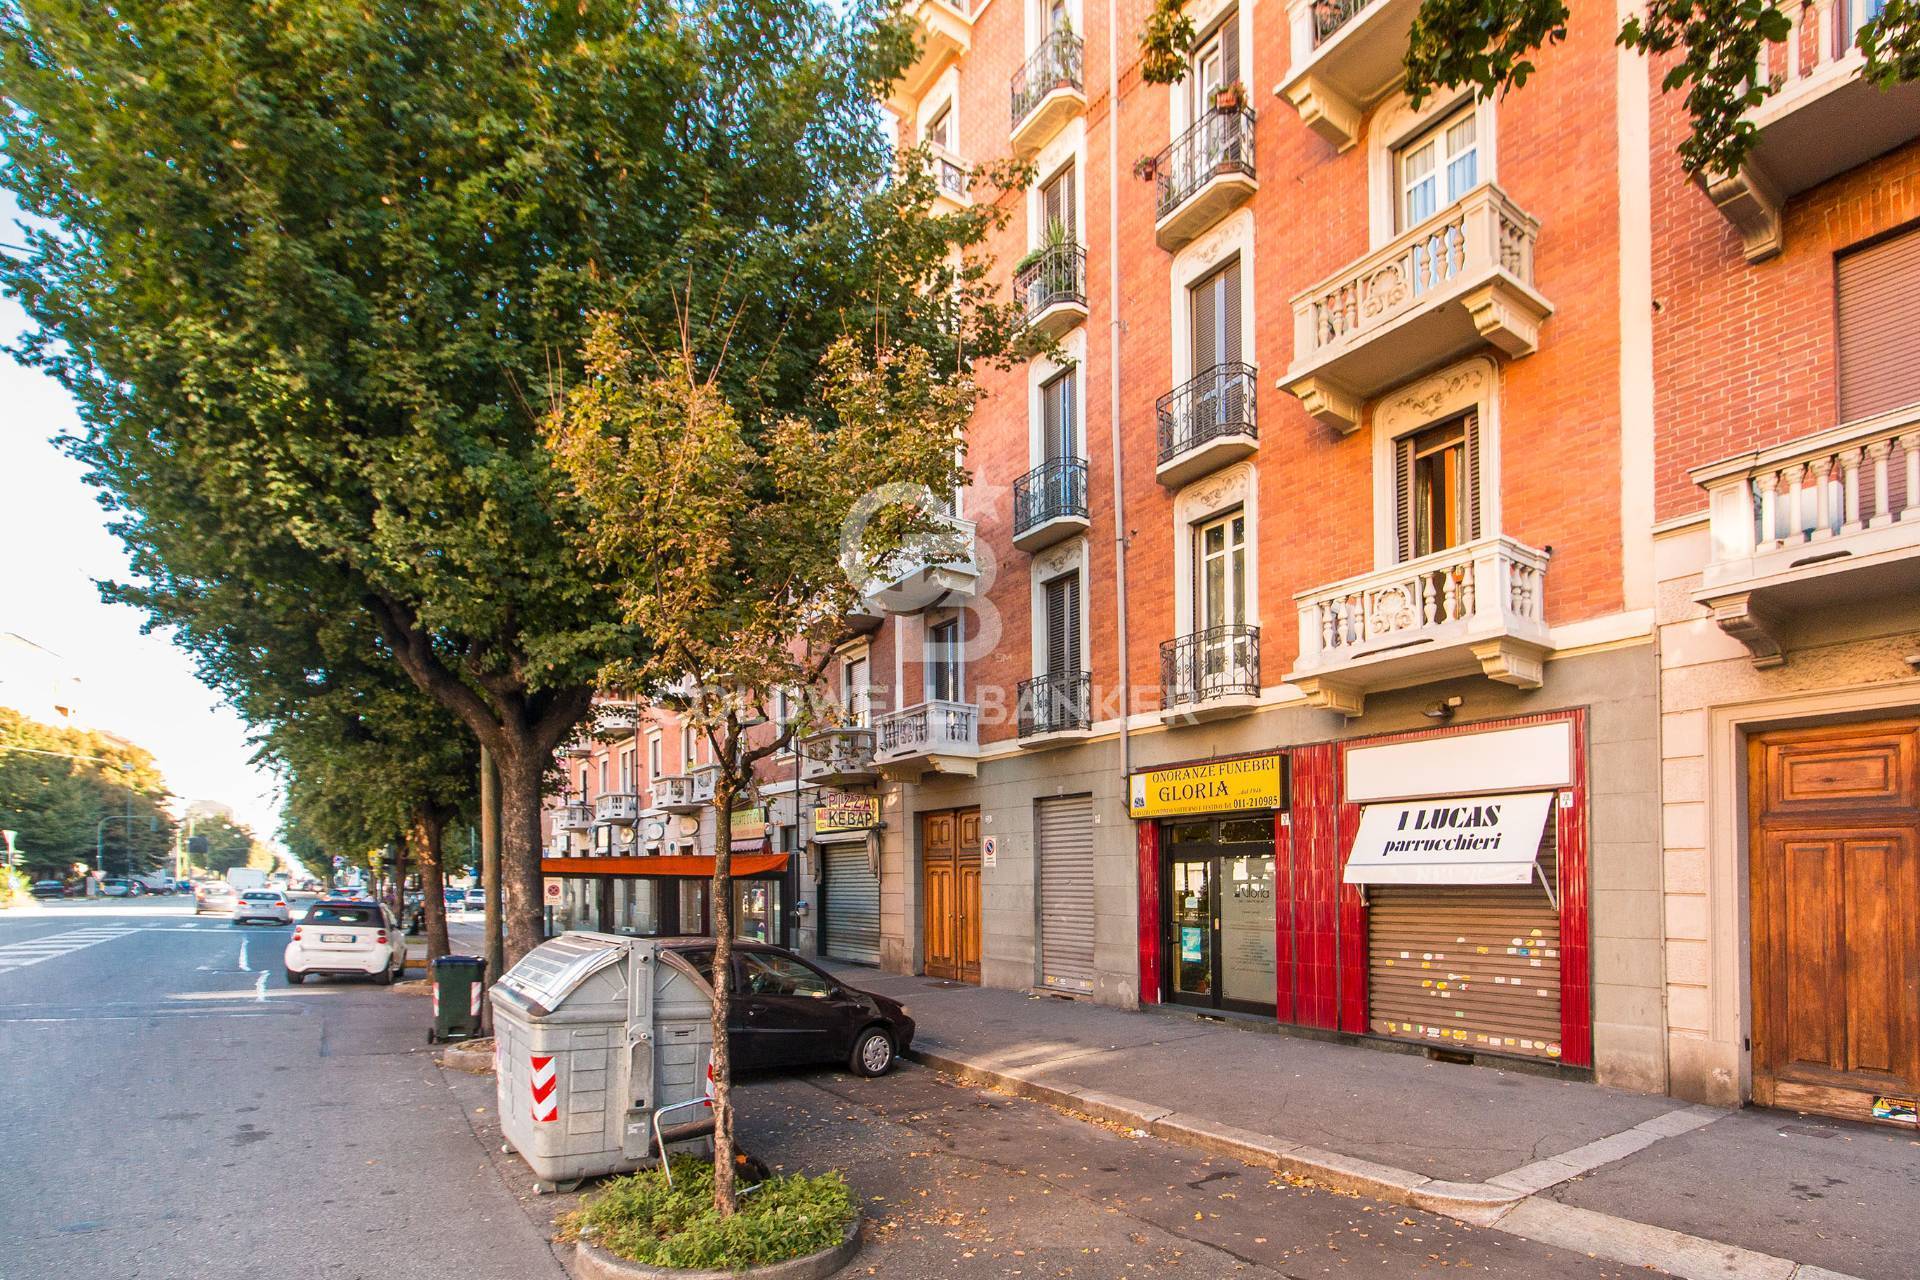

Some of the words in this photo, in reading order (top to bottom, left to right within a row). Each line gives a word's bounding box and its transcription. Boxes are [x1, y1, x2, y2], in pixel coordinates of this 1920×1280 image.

[1152, 765, 1216, 783] ONORANZE
[1219, 758, 1275, 775] FUNEBRI
[827, 793, 872, 809] PIZZA
[1158, 780, 1229, 802] GLORIA
[1233, 795, 1278, 809] 011-210985
[1397, 810, 1410, 831] I
[1414, 804, 1502, 830] LUCAS
[1382, 832, 1503, 857] parrucchieri
